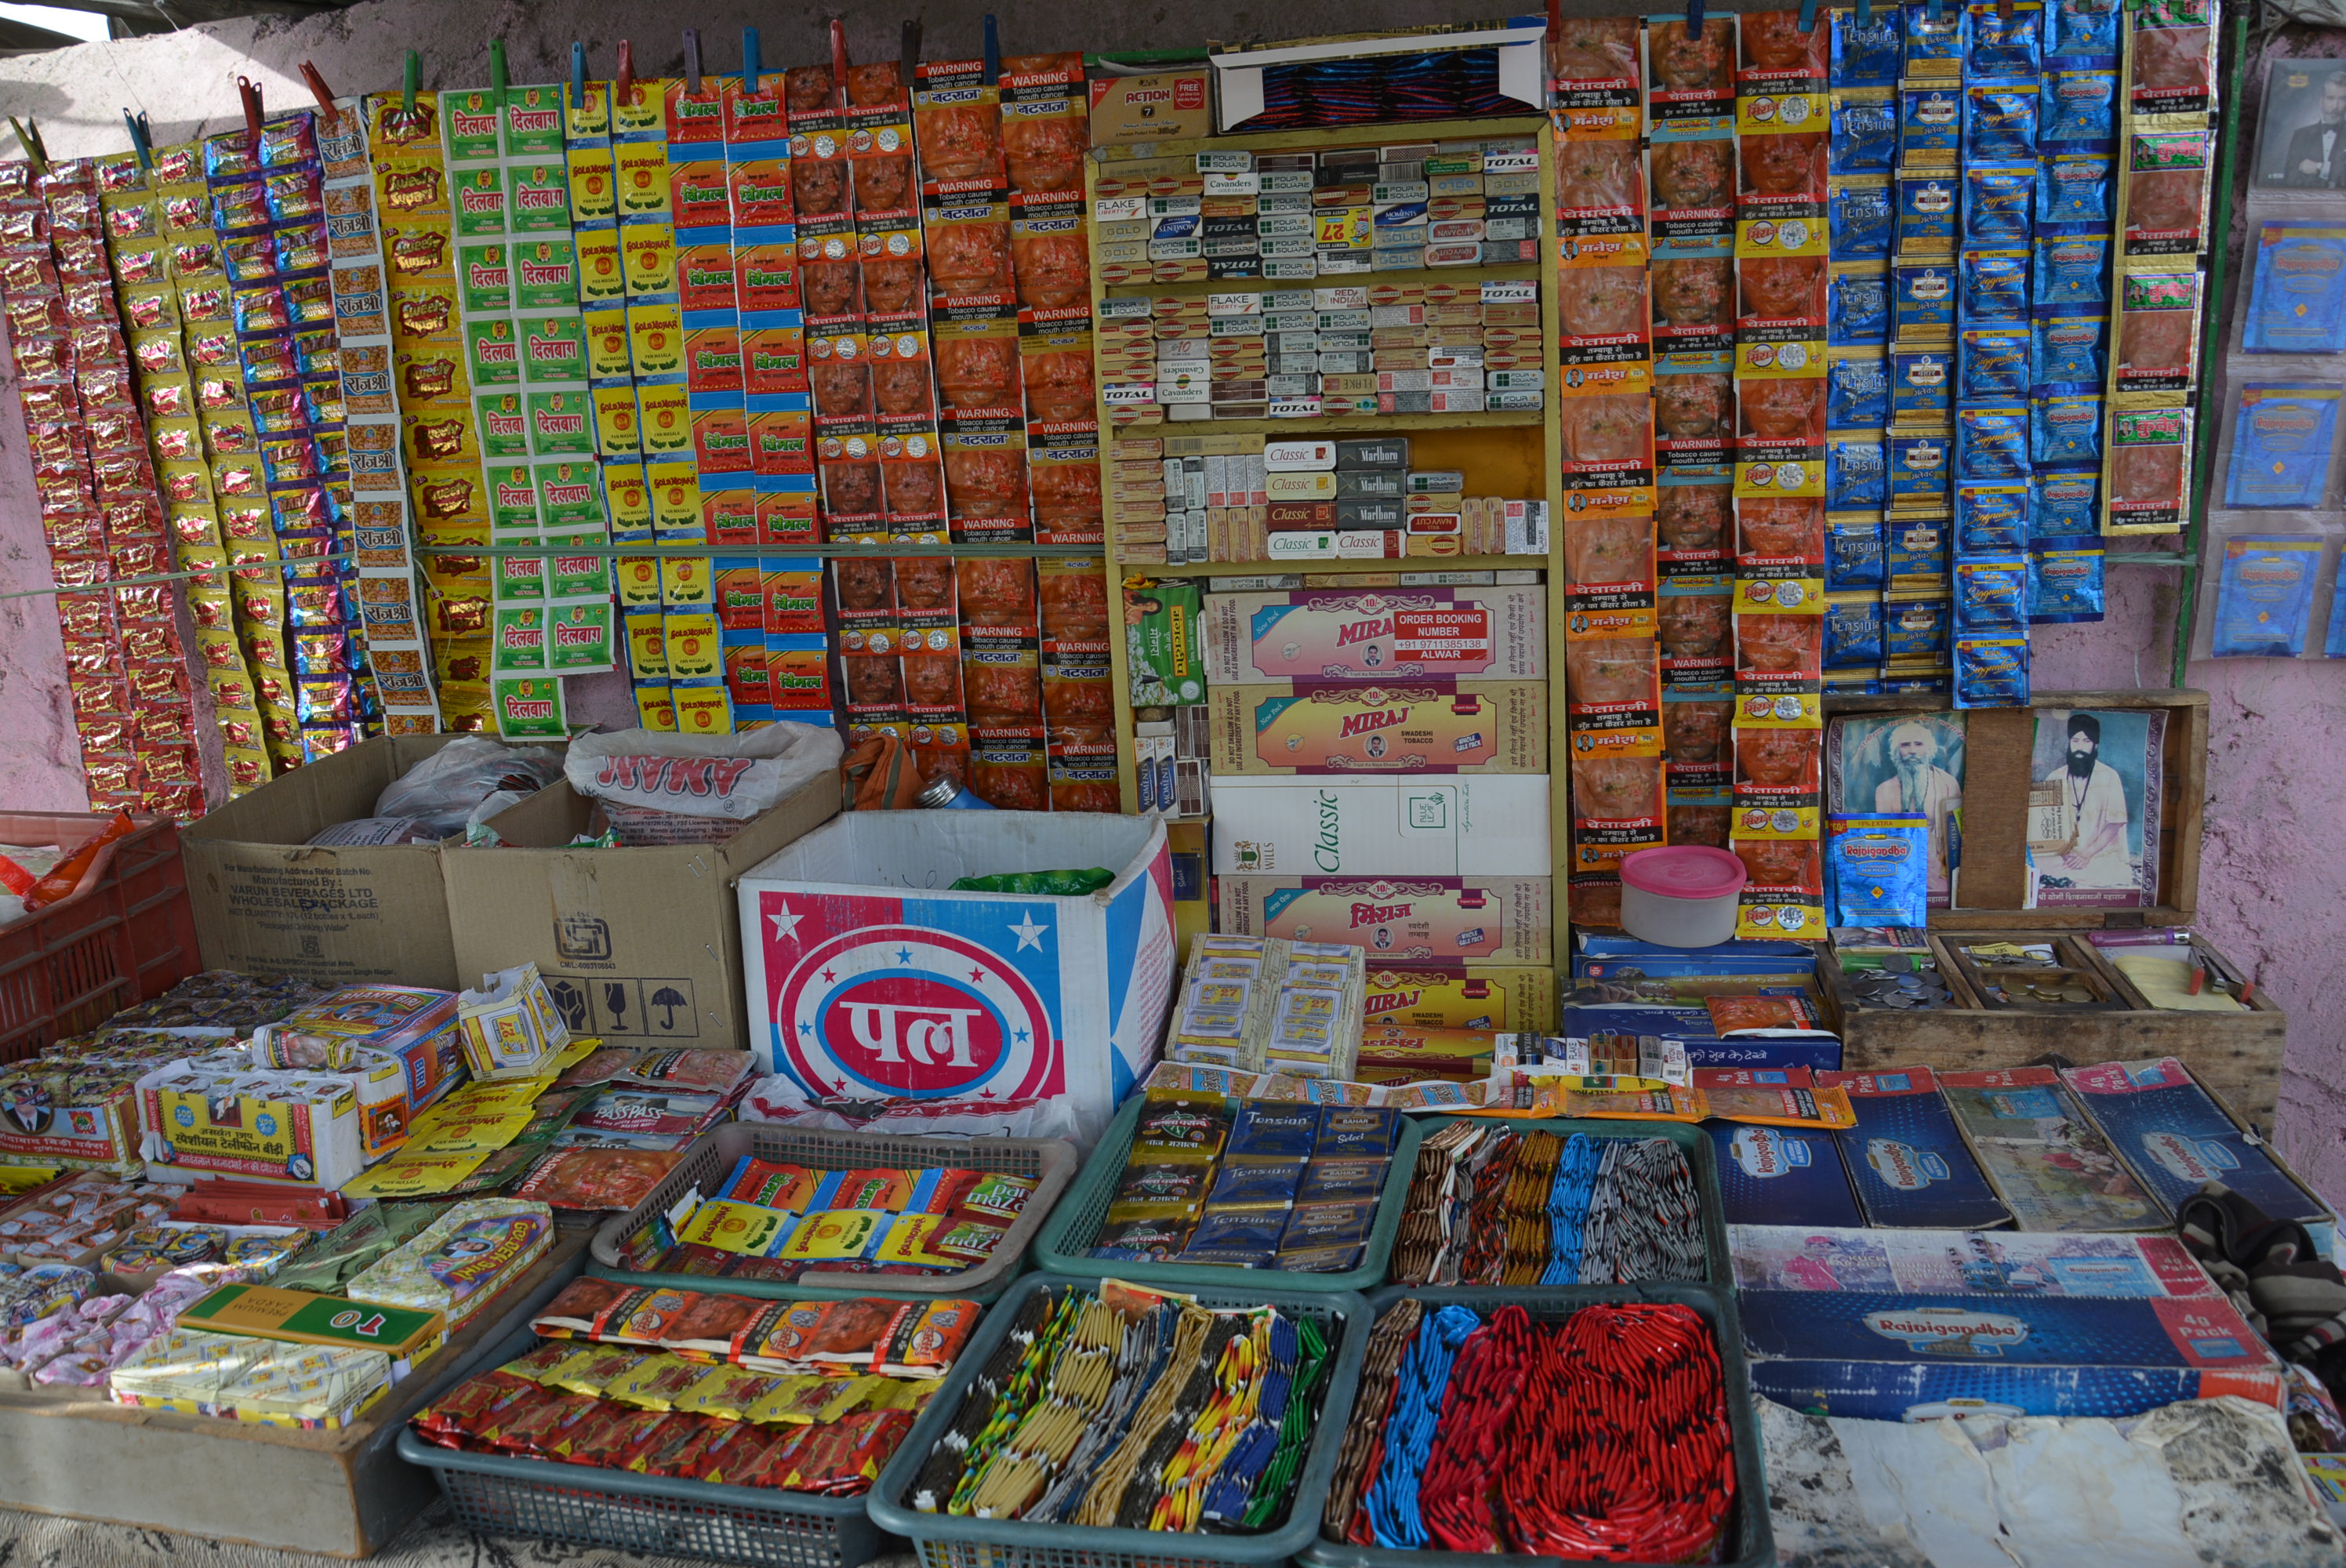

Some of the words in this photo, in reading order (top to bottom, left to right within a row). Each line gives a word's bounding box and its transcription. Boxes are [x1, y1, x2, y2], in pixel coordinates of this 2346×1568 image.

[928, 62, 982, 76] WARNING
[928, 74, 955, 83] Tobacco
[1011, 72, 1068, 86] WARNING
[931, 89, 982, 103] नटराज
[1013, 86, 1042, 95] Tobacco
[1125, 89, 1171, 105] ACTION
[1016, 100, 1069, 114] नटराज
[510, 108, 558, 132] दिलबाग
[322, 136, 365, 158] राजश्री
[1486, 158, 1535, 167] TOTAL
[1211, 180, 1252, 189] Cavanders
[517, 187, 564, 209] दिलबाग
[282, 204, 310, 213] SUPARI
[1098, 200, 1135, 209] FLAKE
[1488, 203, 1537, 213] TOTAL
[1385, 209, 1417, 219] MOMENTS
[331, 215, 372, 237] राजश्री
[1107, 227, 1141, 235] GOLD
[1158, 223, 1195, 233] MOMENTS
[1206, 223, 1253, 233] TOTAL
[1321, 224, 1344, 241] 27
[2135, 230, 2191, 239] चेतावनी
[1213, 260, 1258, 270] TOTAL
[1379, 255, 1418, 264] GOLD
[521, 260, 569, 285] दिलबाग
[1484, 289, 1532, 298] TOTAL
[337, 295, 381, 315] राजश्री
[1211, 296, 1249, 304] FLAKE
[1330, 296, 1364, 304] INDIAN
[1570, 336, 1639, 347] चेतावनी
[1105, 390, 1150, 399] TOTAL
[1162, 388, 1203, 397] Cavanders
[1271, 404, 1318, 413] TOTAL
[1671, 440, 1721, 449] WARNING
[1270, 448, 1309, 462] Classic
[1361, 448, 1398, 462] Marlboro
[1272, 478, 1311, 490] Classic
[1360, 478, 1397, 492] Marlboro
[1272, 508, 1311, 521] Classic
[1360, 508, 1396, 521] Marlboro
[1273, 538, 1312, 550] Classic
[1340, 535, 1381, 549] Classic
[1399, 615, 1433, 624] ORDER
[1436, 614, 1482, 624] BOOKING
[555, 622, 602, 646] दिलबाग
[971, 626, 1022, 637] WARNING
[1418, 627, 1460, 636] NUMBER
[971, 637, 997, 645] Tobacco
[973, 651, 1022, 663] नटराज
[506, 696, 552, 718] दिलबाग
[1580, 702, 1648, 713] चेतावनी
[1260, 713, 1273, 726] New
[1270, 701, 1283, 714] Pack
[1339, 707, 1410, 739] MIRAJ
[1314, 789, 1340, 873] Classic
[1265, 842, 1274, 870] WILLS
[1846, 845, 1908, 858] Rajnigandha
[238, 865, 283, 874] Manufacturing
[252, 876, 319, 886] Manufactured
[322, 877, 336, 887] By
[231, 885, 268, 896] VARUN
[273, 887, 346, 898] BEVERAGES
[349, 888, 372, 898] LTD
[229, 895, 308, 908] WHOLESALE
[1349, 902, 1411, 929] मिराज
[1220, 988, 1238, 997] 27
[340, 991, 394, 1004] SHANTI
[394, 994, 423, 1009] BIRI
[839, 1000, 982, 1068] पल
[413, 1058, 427, 1091] BIRI
[1737, 1070, 1749, 1084] Pack
[176, 1109, 191, 1119] 500
[1338, 1133, 1364, 1144] Select
[1749, 1128, 1774, 1174] Rajnigandha
[1884, 1143, 1916, 1187] Rajnigandha
[1307, 1225, 1338, 1235] Select
[2184, 1314, 2210, 1327] 4g
[1879, 1319, 2017, 1337] Rajnigandha
[2179, 1326, 2233, 1337] Pack
